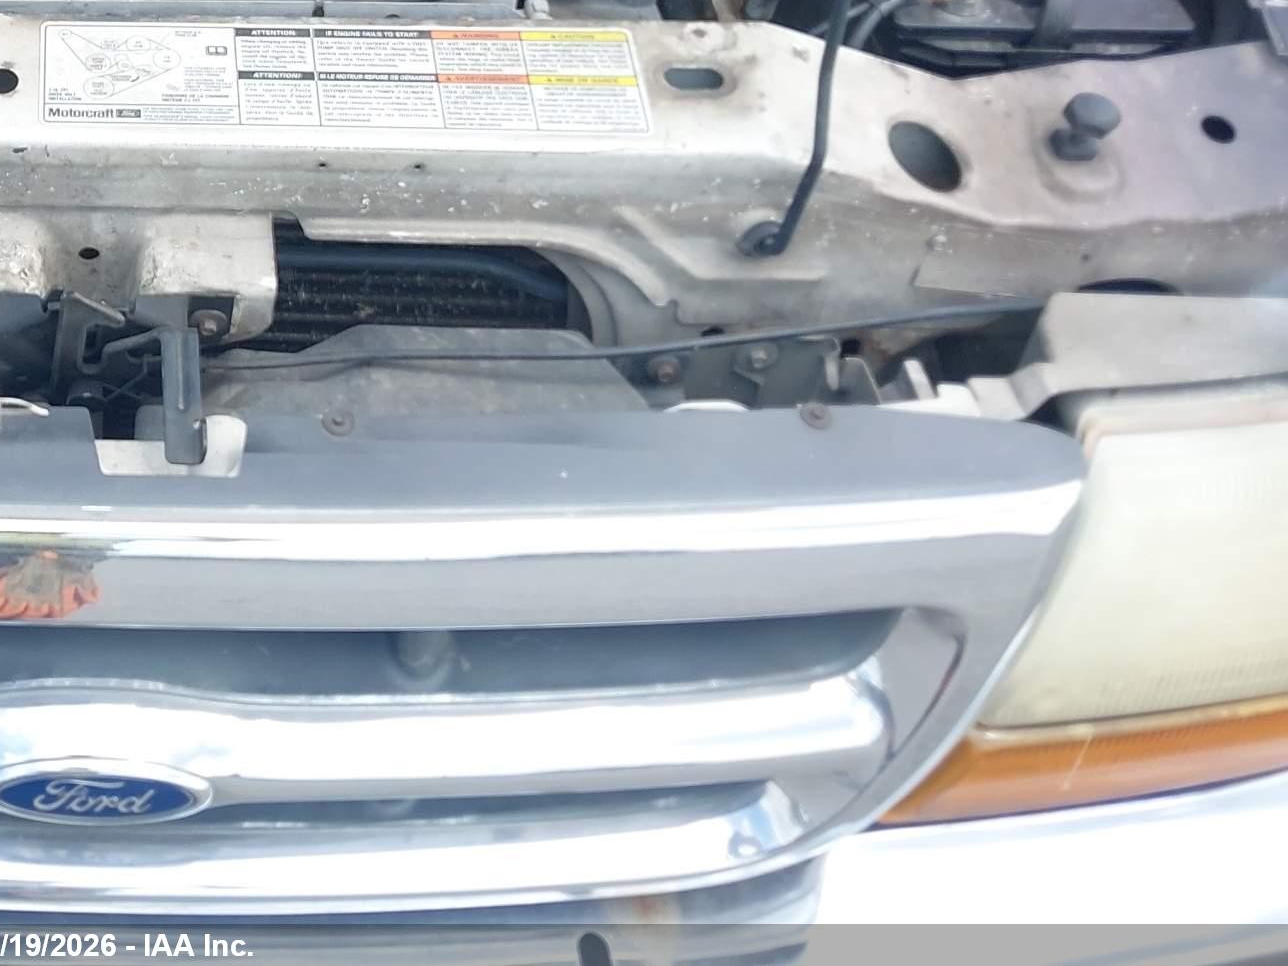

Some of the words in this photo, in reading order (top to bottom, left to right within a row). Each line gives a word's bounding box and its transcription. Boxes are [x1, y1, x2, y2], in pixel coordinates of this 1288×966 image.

[250, 29, 297, 37] ATTENTION
[48, 108, 114, 119] Motorcraft
[32, 778, 155, 813] Ford
